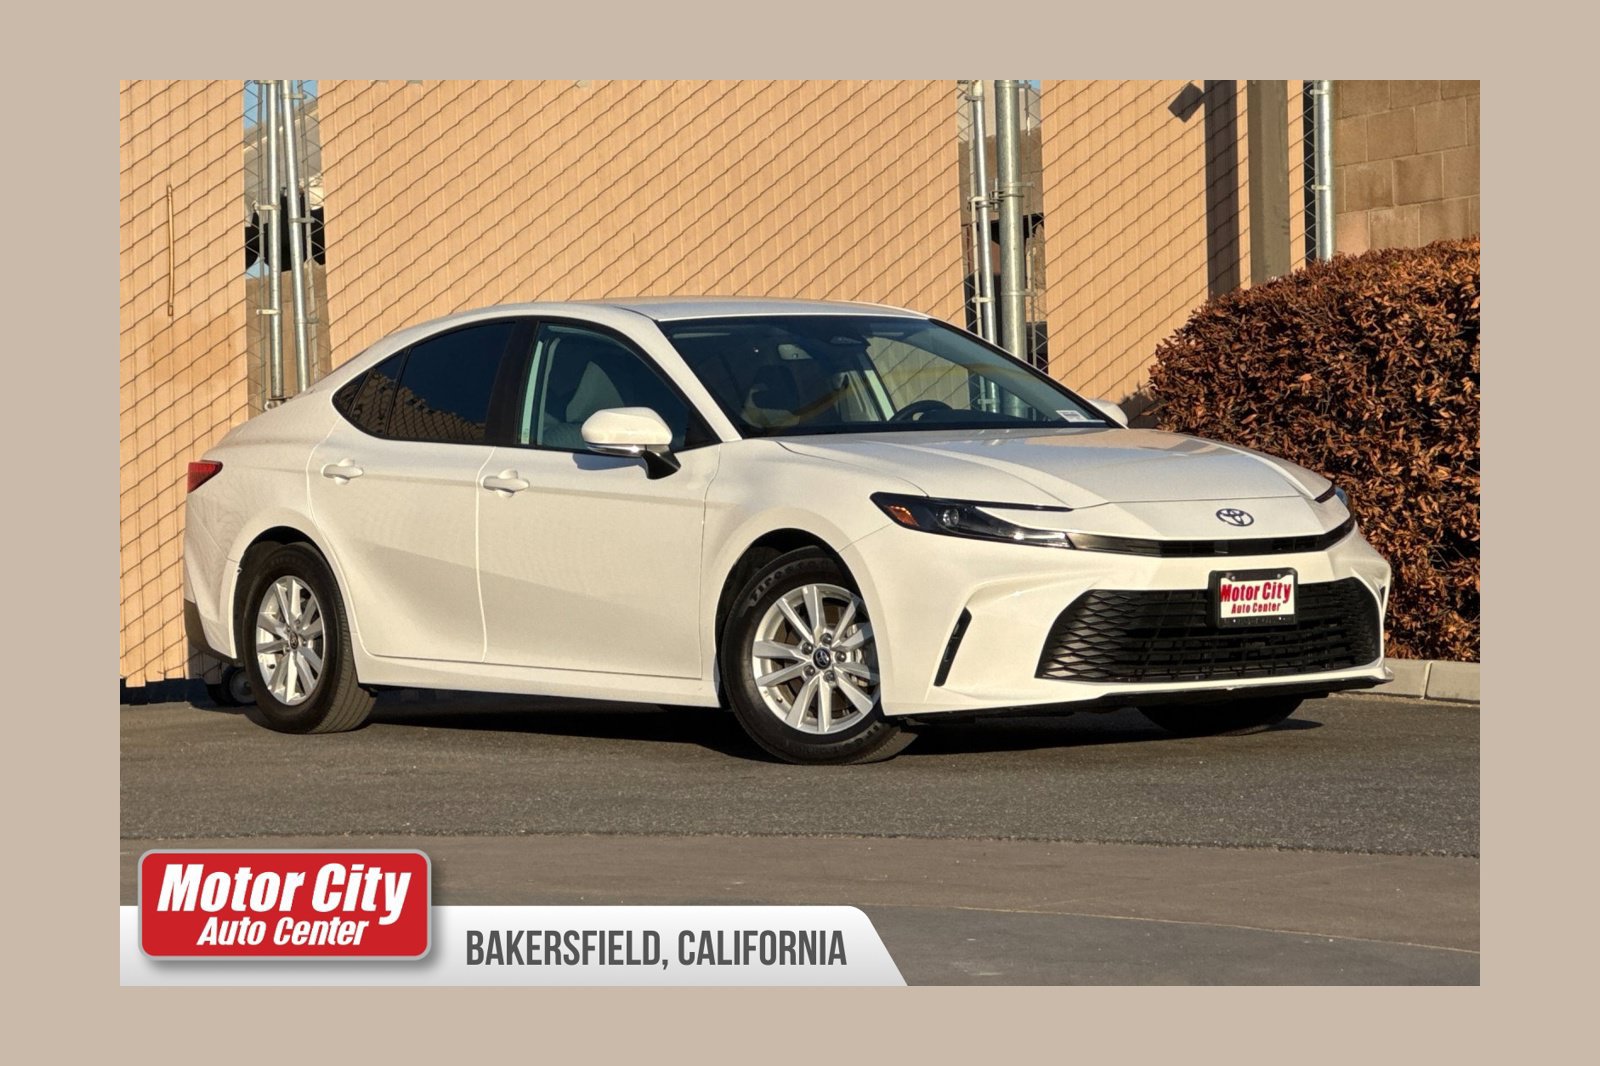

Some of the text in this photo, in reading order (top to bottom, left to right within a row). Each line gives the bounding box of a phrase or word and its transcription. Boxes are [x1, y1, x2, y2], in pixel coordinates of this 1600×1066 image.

[1219, 581, 1291, 604] Motor City
[1231, 602, 1281, 615] Auto Center
